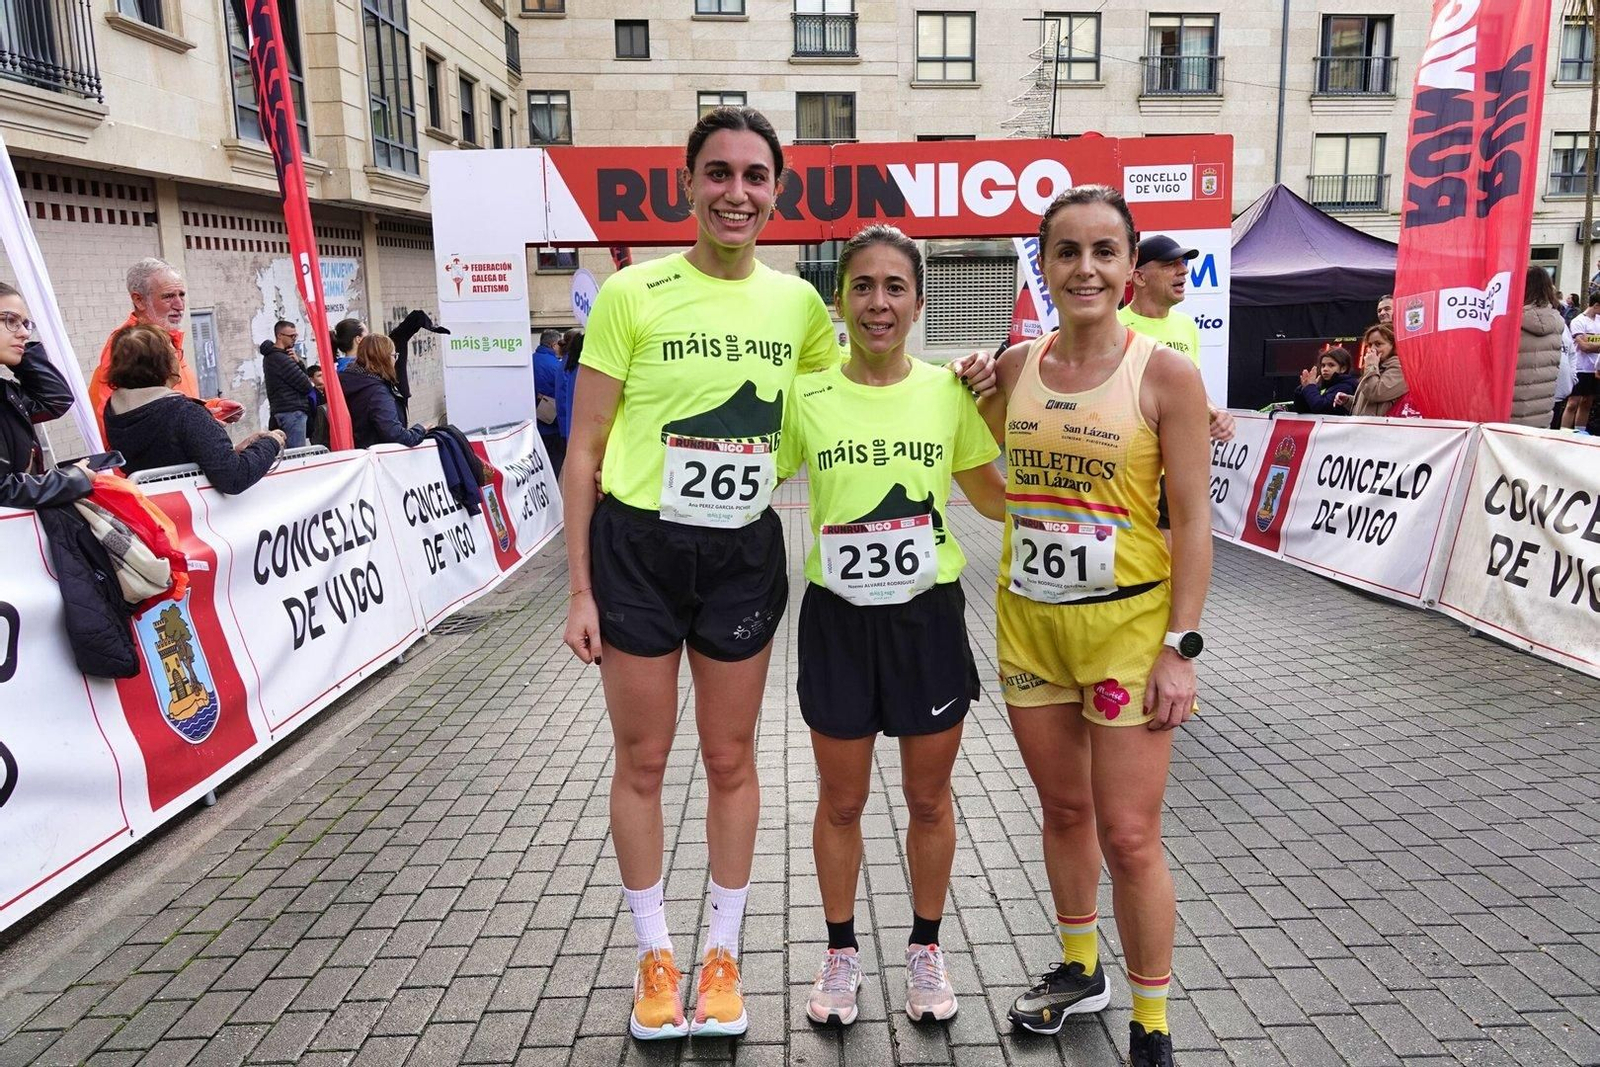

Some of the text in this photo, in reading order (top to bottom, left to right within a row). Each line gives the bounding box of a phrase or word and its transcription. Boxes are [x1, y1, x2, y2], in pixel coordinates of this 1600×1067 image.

[1129, 172, 1187, 183] CONCELLO
[1136, 183, 1180, 194] DE VIGO
[471, 262, 512, 272] FEDERACIÓN
[472, 274, 507, 283] GALEGA DE
[472, 284, 509, 293] ATLETISMO
[451, 335, 481, 350] máis
[492, 337, 523, 352] auga
[663, 332, 792, 367] máis que auga
[1063, 423, 1120, 441] San Lázaro
[817, 439, 943, 471] máis que auga
[680, 460, 761, 501] 265
[1015, 469, 1092, 493] San Lázaro
[1317, 454, 1433, 500] CONCELLO
[1311, 499, 1398, 546] DE VIGO
[253, 498, 377, 586] CONCELLO
[422, 533, 447, 575] DE
[839, 539, 920, 580] 236
[1022, 538, 1087, 581] 261
[1486, 533, 1541, 588] DE
[282, 560, 384, 651] DE VIGO
